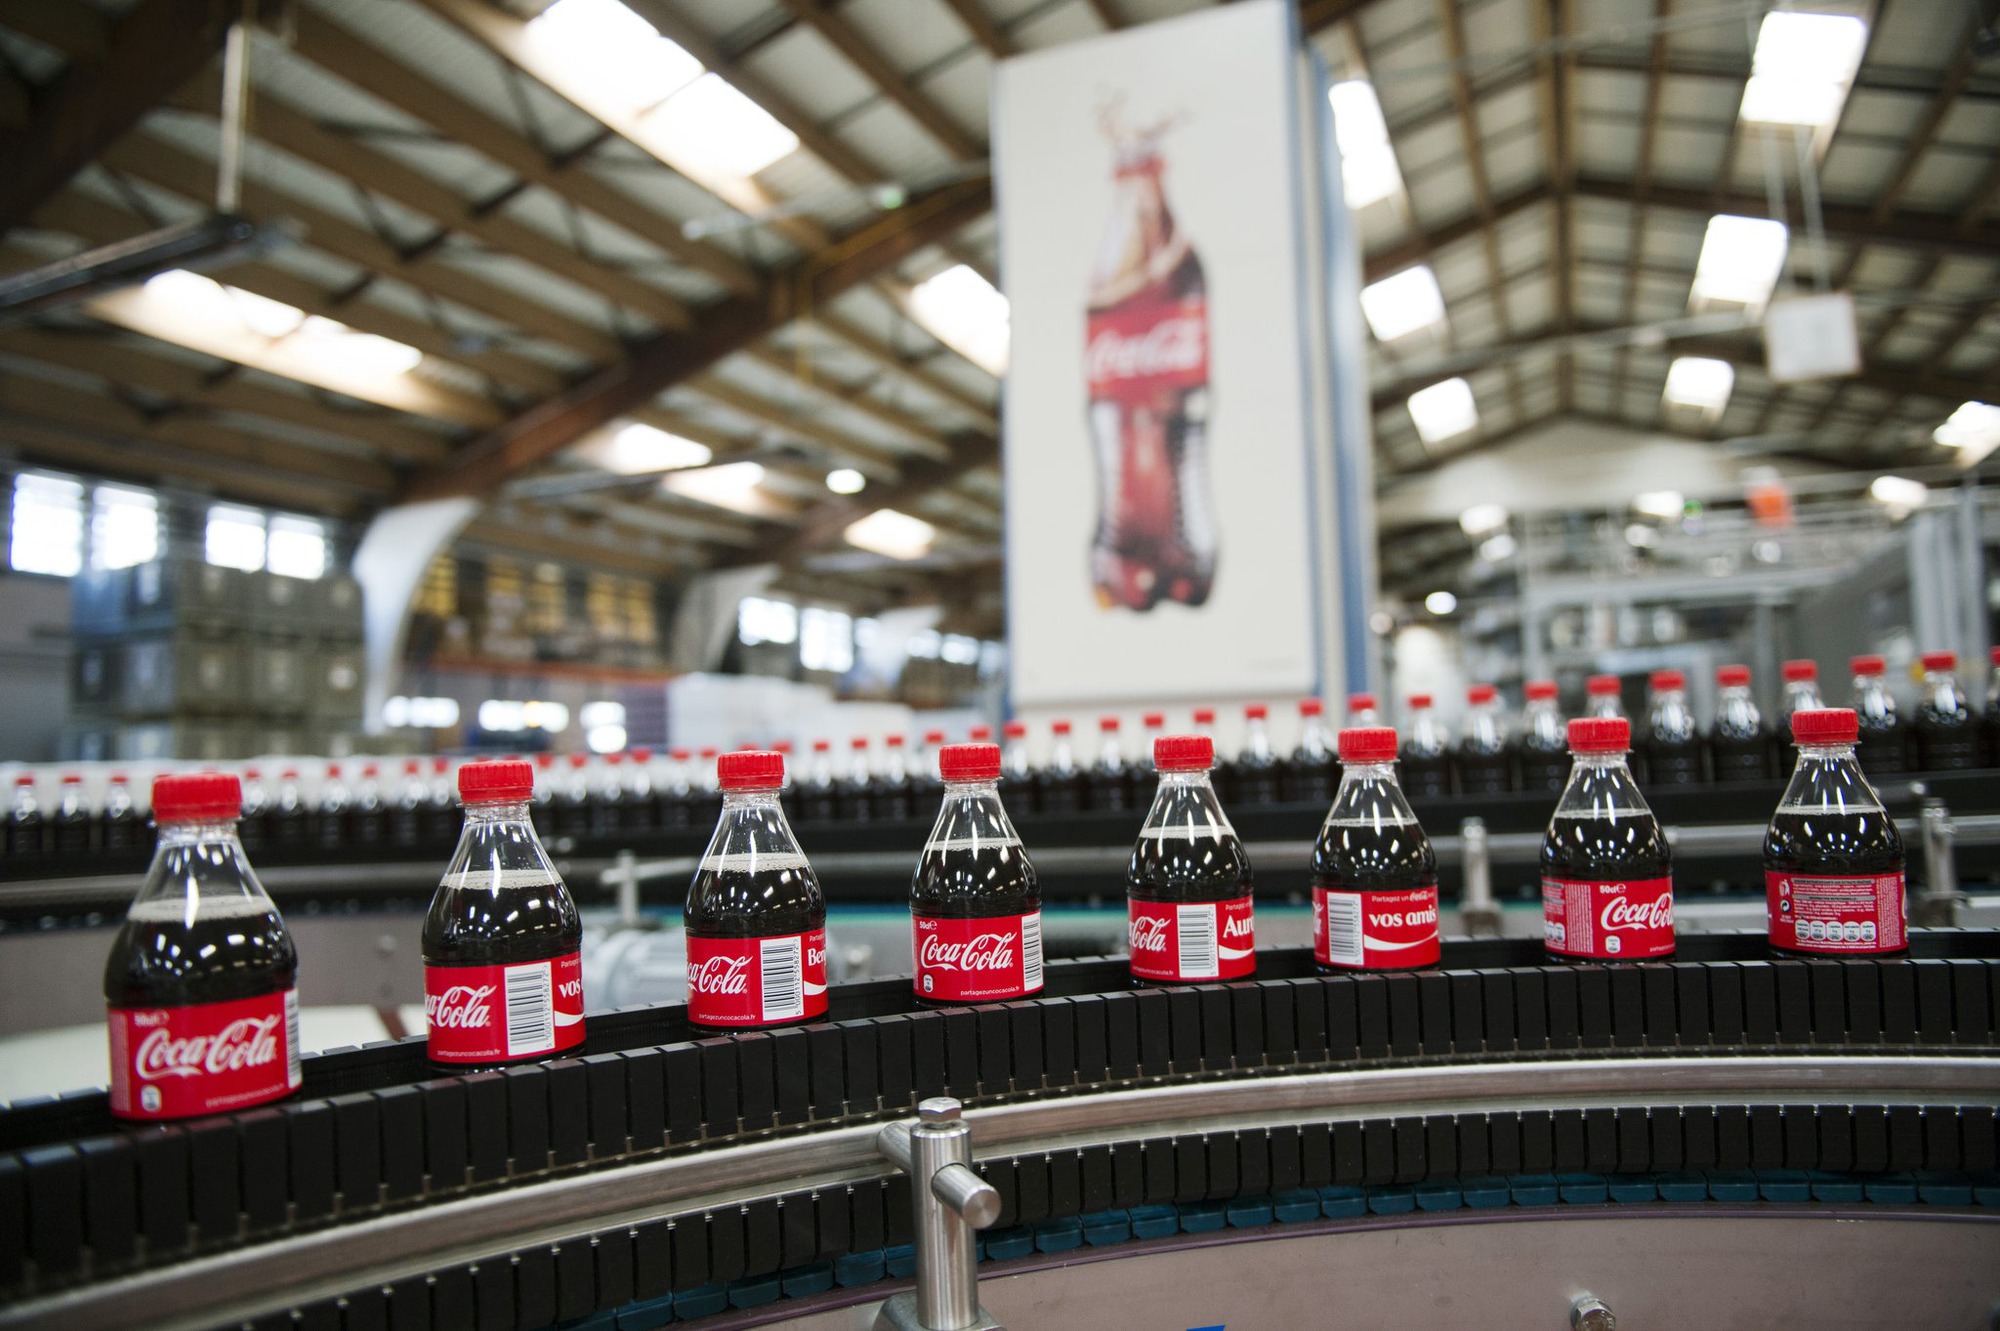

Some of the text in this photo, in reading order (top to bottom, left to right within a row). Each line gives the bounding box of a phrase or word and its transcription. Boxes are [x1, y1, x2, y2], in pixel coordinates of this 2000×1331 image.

[1600, 885, 1617, 894] 50cl
[1368, 904, 1436, 928] vos amis
[920, 931, 1018, 972] Coca-Cola
[960, 986, 1020, 996] partagezuncocacola.fr
[135, 1013, 282, 1080] Coca-Cola
